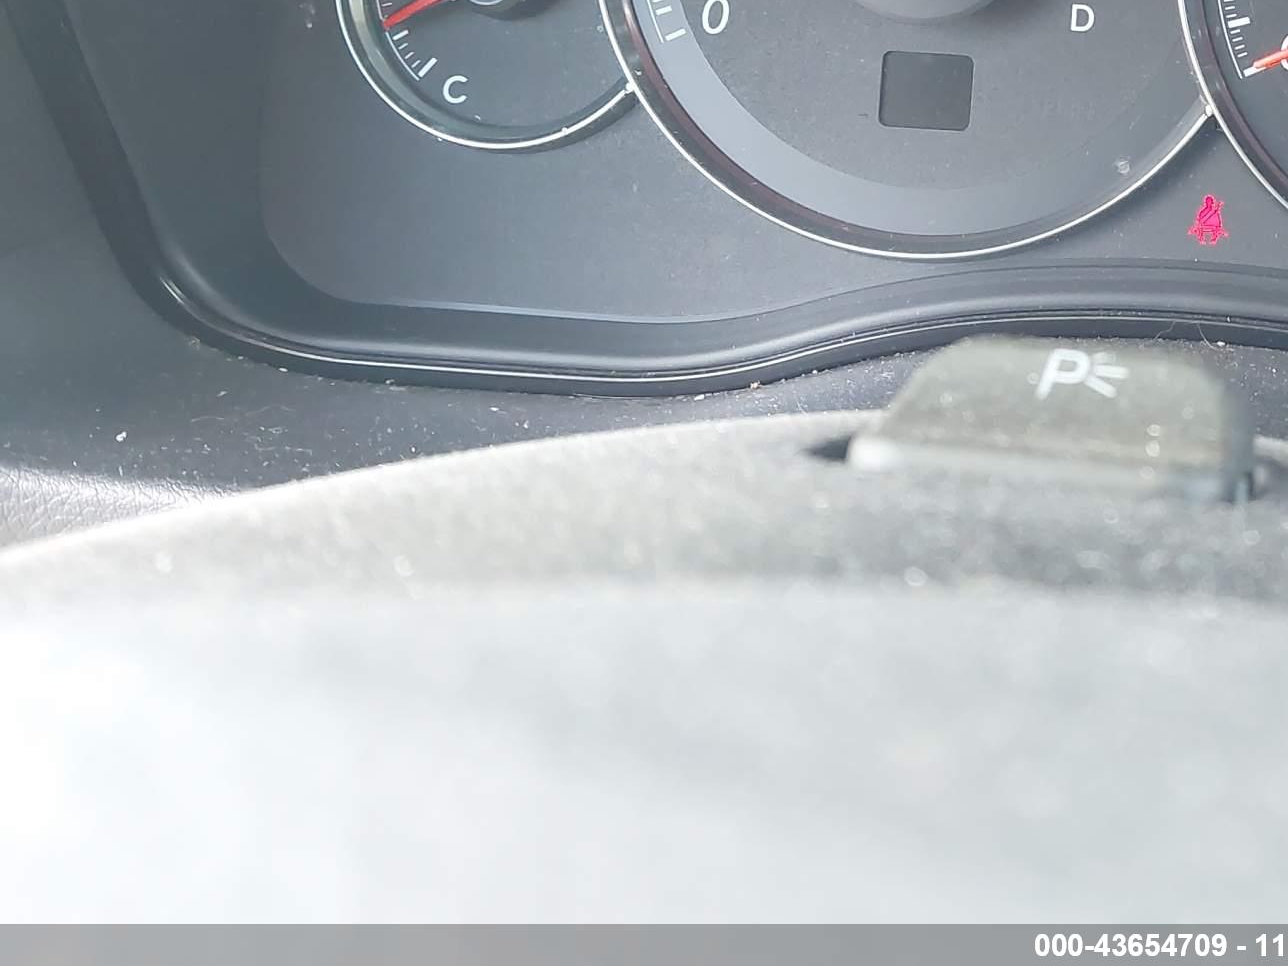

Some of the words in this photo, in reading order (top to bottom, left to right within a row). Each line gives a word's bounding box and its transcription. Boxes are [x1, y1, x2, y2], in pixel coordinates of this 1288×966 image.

[1071, 4, 1094, 31] D
[443, 76, 467, 103] C
[1036, 348, 1091, 399] P
